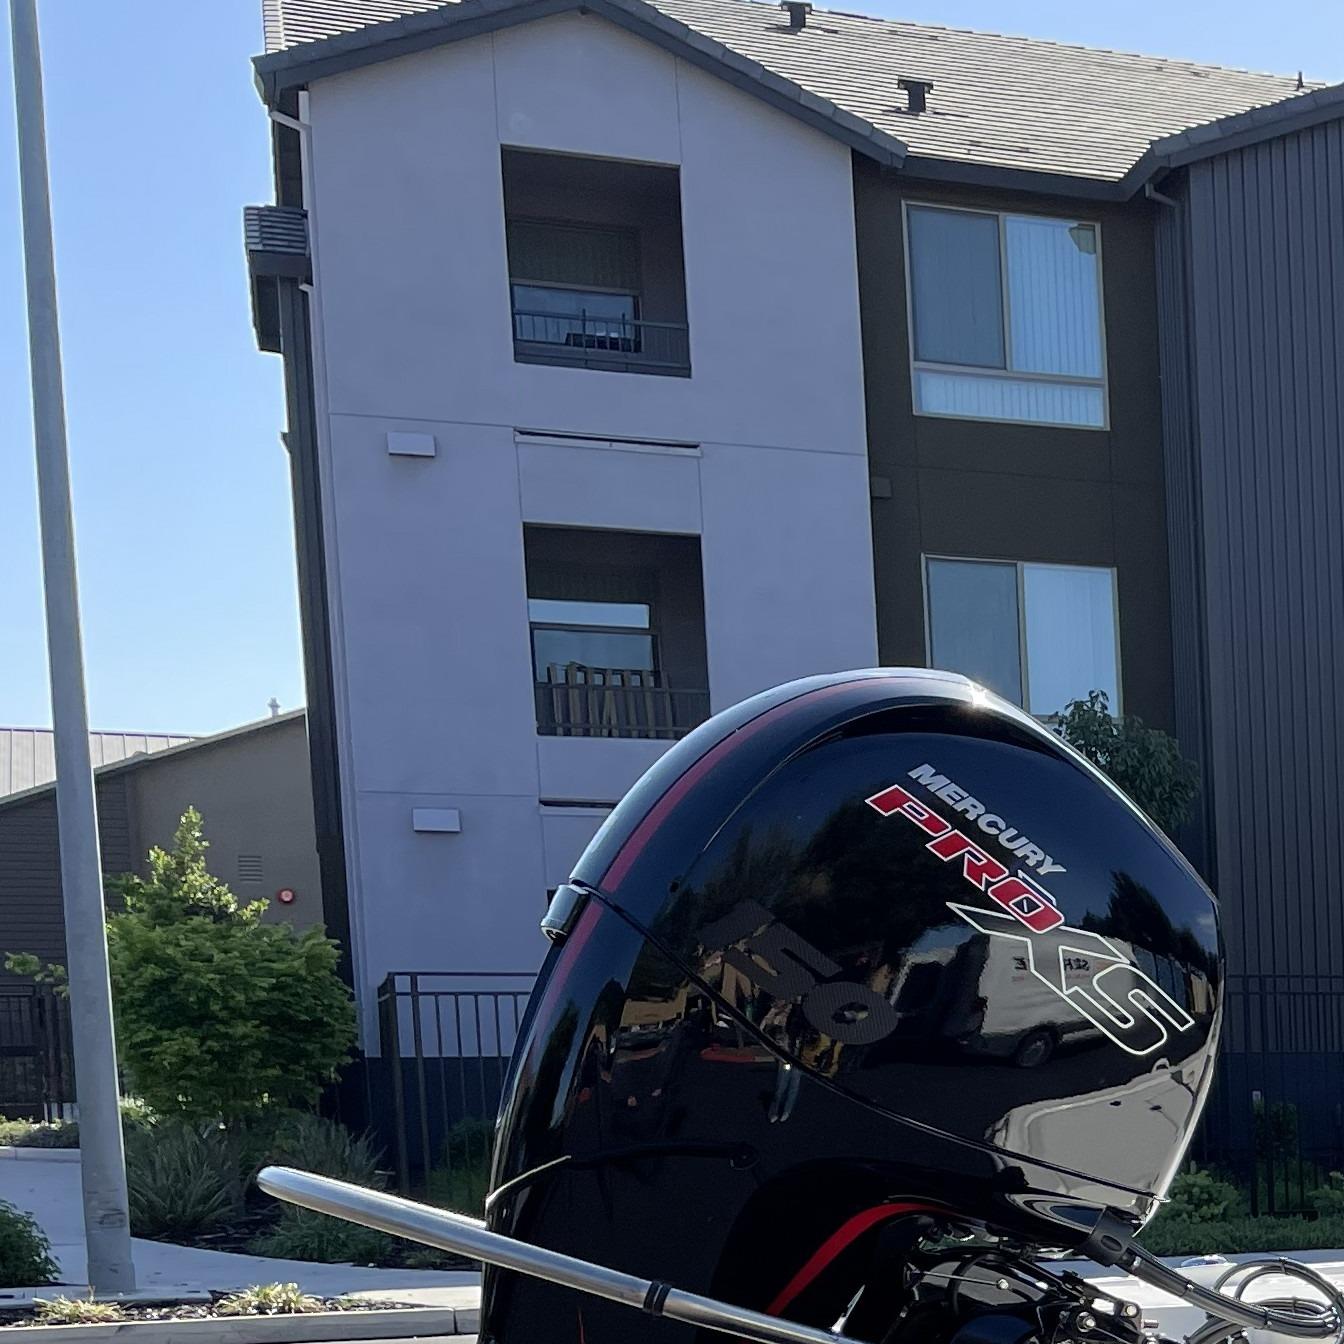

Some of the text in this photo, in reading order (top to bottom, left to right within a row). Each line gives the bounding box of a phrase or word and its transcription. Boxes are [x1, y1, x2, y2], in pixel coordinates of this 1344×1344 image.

[907, 764, 1066, 876] MERCURY
[864, 784, 1194, 1056] PRO XS
